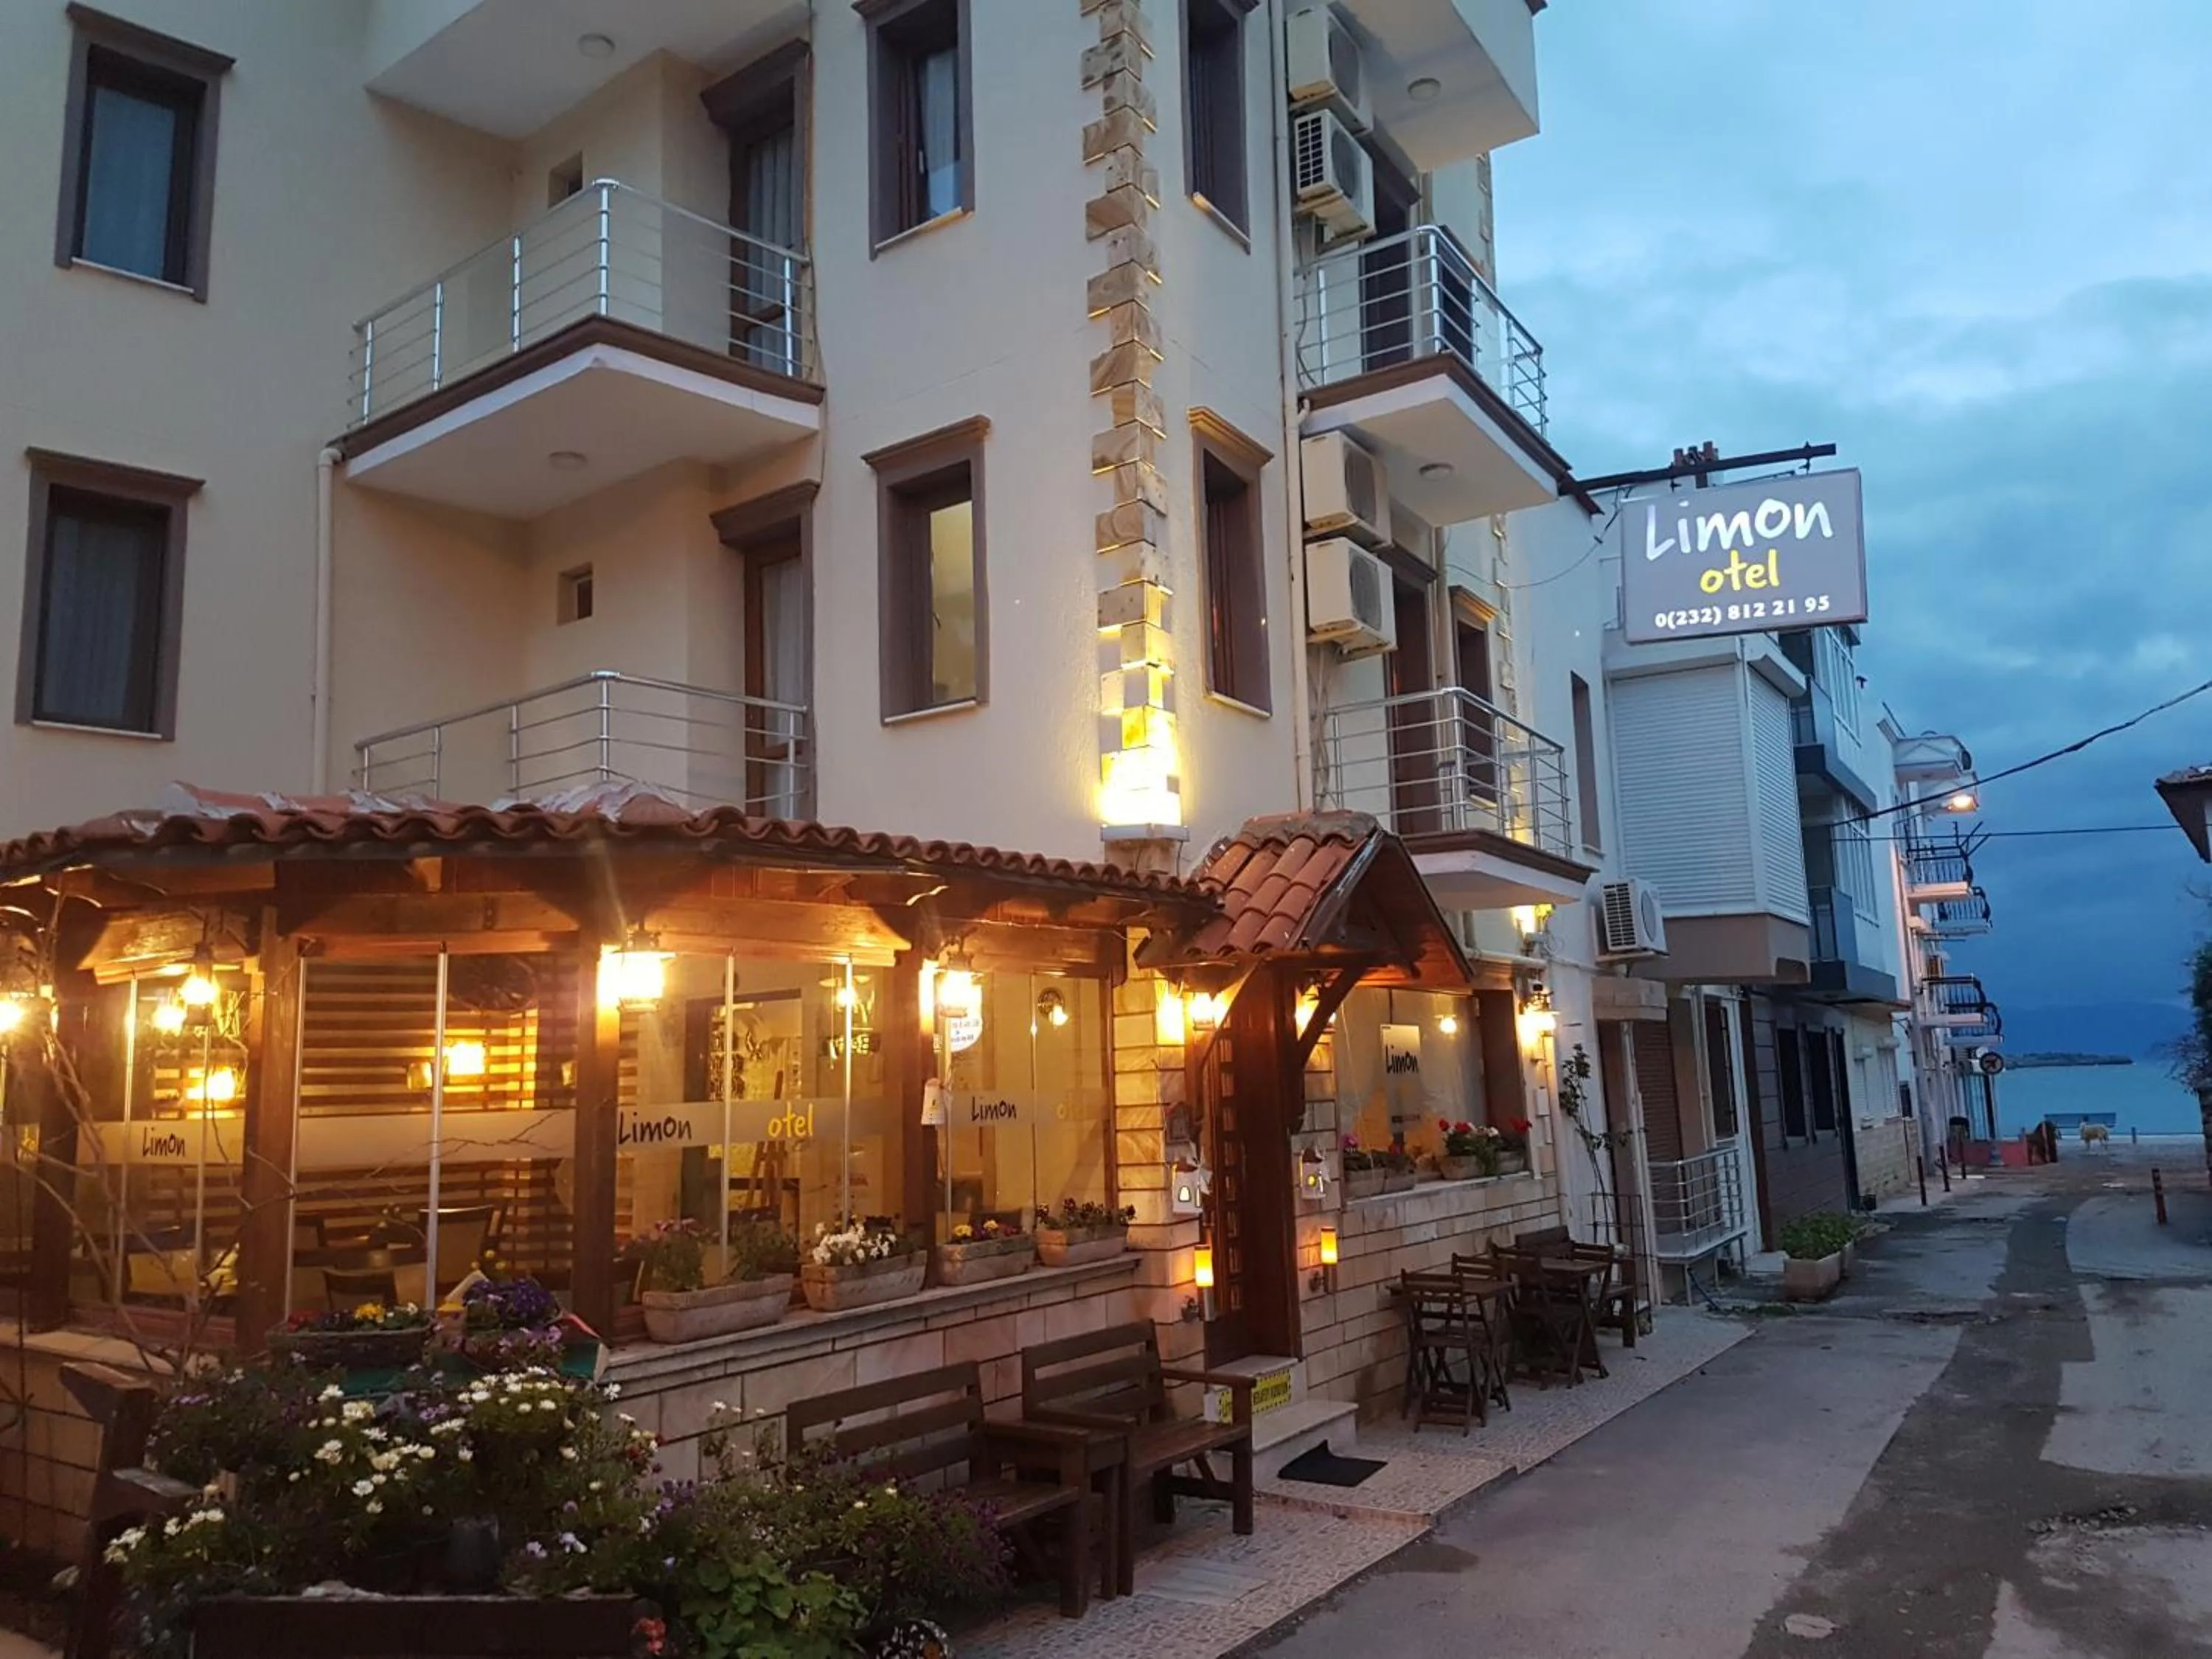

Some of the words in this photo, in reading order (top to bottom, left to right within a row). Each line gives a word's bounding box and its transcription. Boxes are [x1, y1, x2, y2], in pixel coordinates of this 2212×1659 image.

[1646, 498, 1834, 561] Limon
[1700, 549, 1780, 594] otel
[1655, 605, 1722, 630] 0(232)
[1728, 604, 1766, 622] 812
[1772, 599, 1795, 616] 21
[1805, 595, 1830, 613] 95
[1385, 1044, 1419, 1074] Limon
[618, 1111, 692, 1144] Limon
[768, 1101, 814, 1138] otel
[971, 1096, 1017, 1121] Limon
[142, 1127, 185, 1157] Limon
